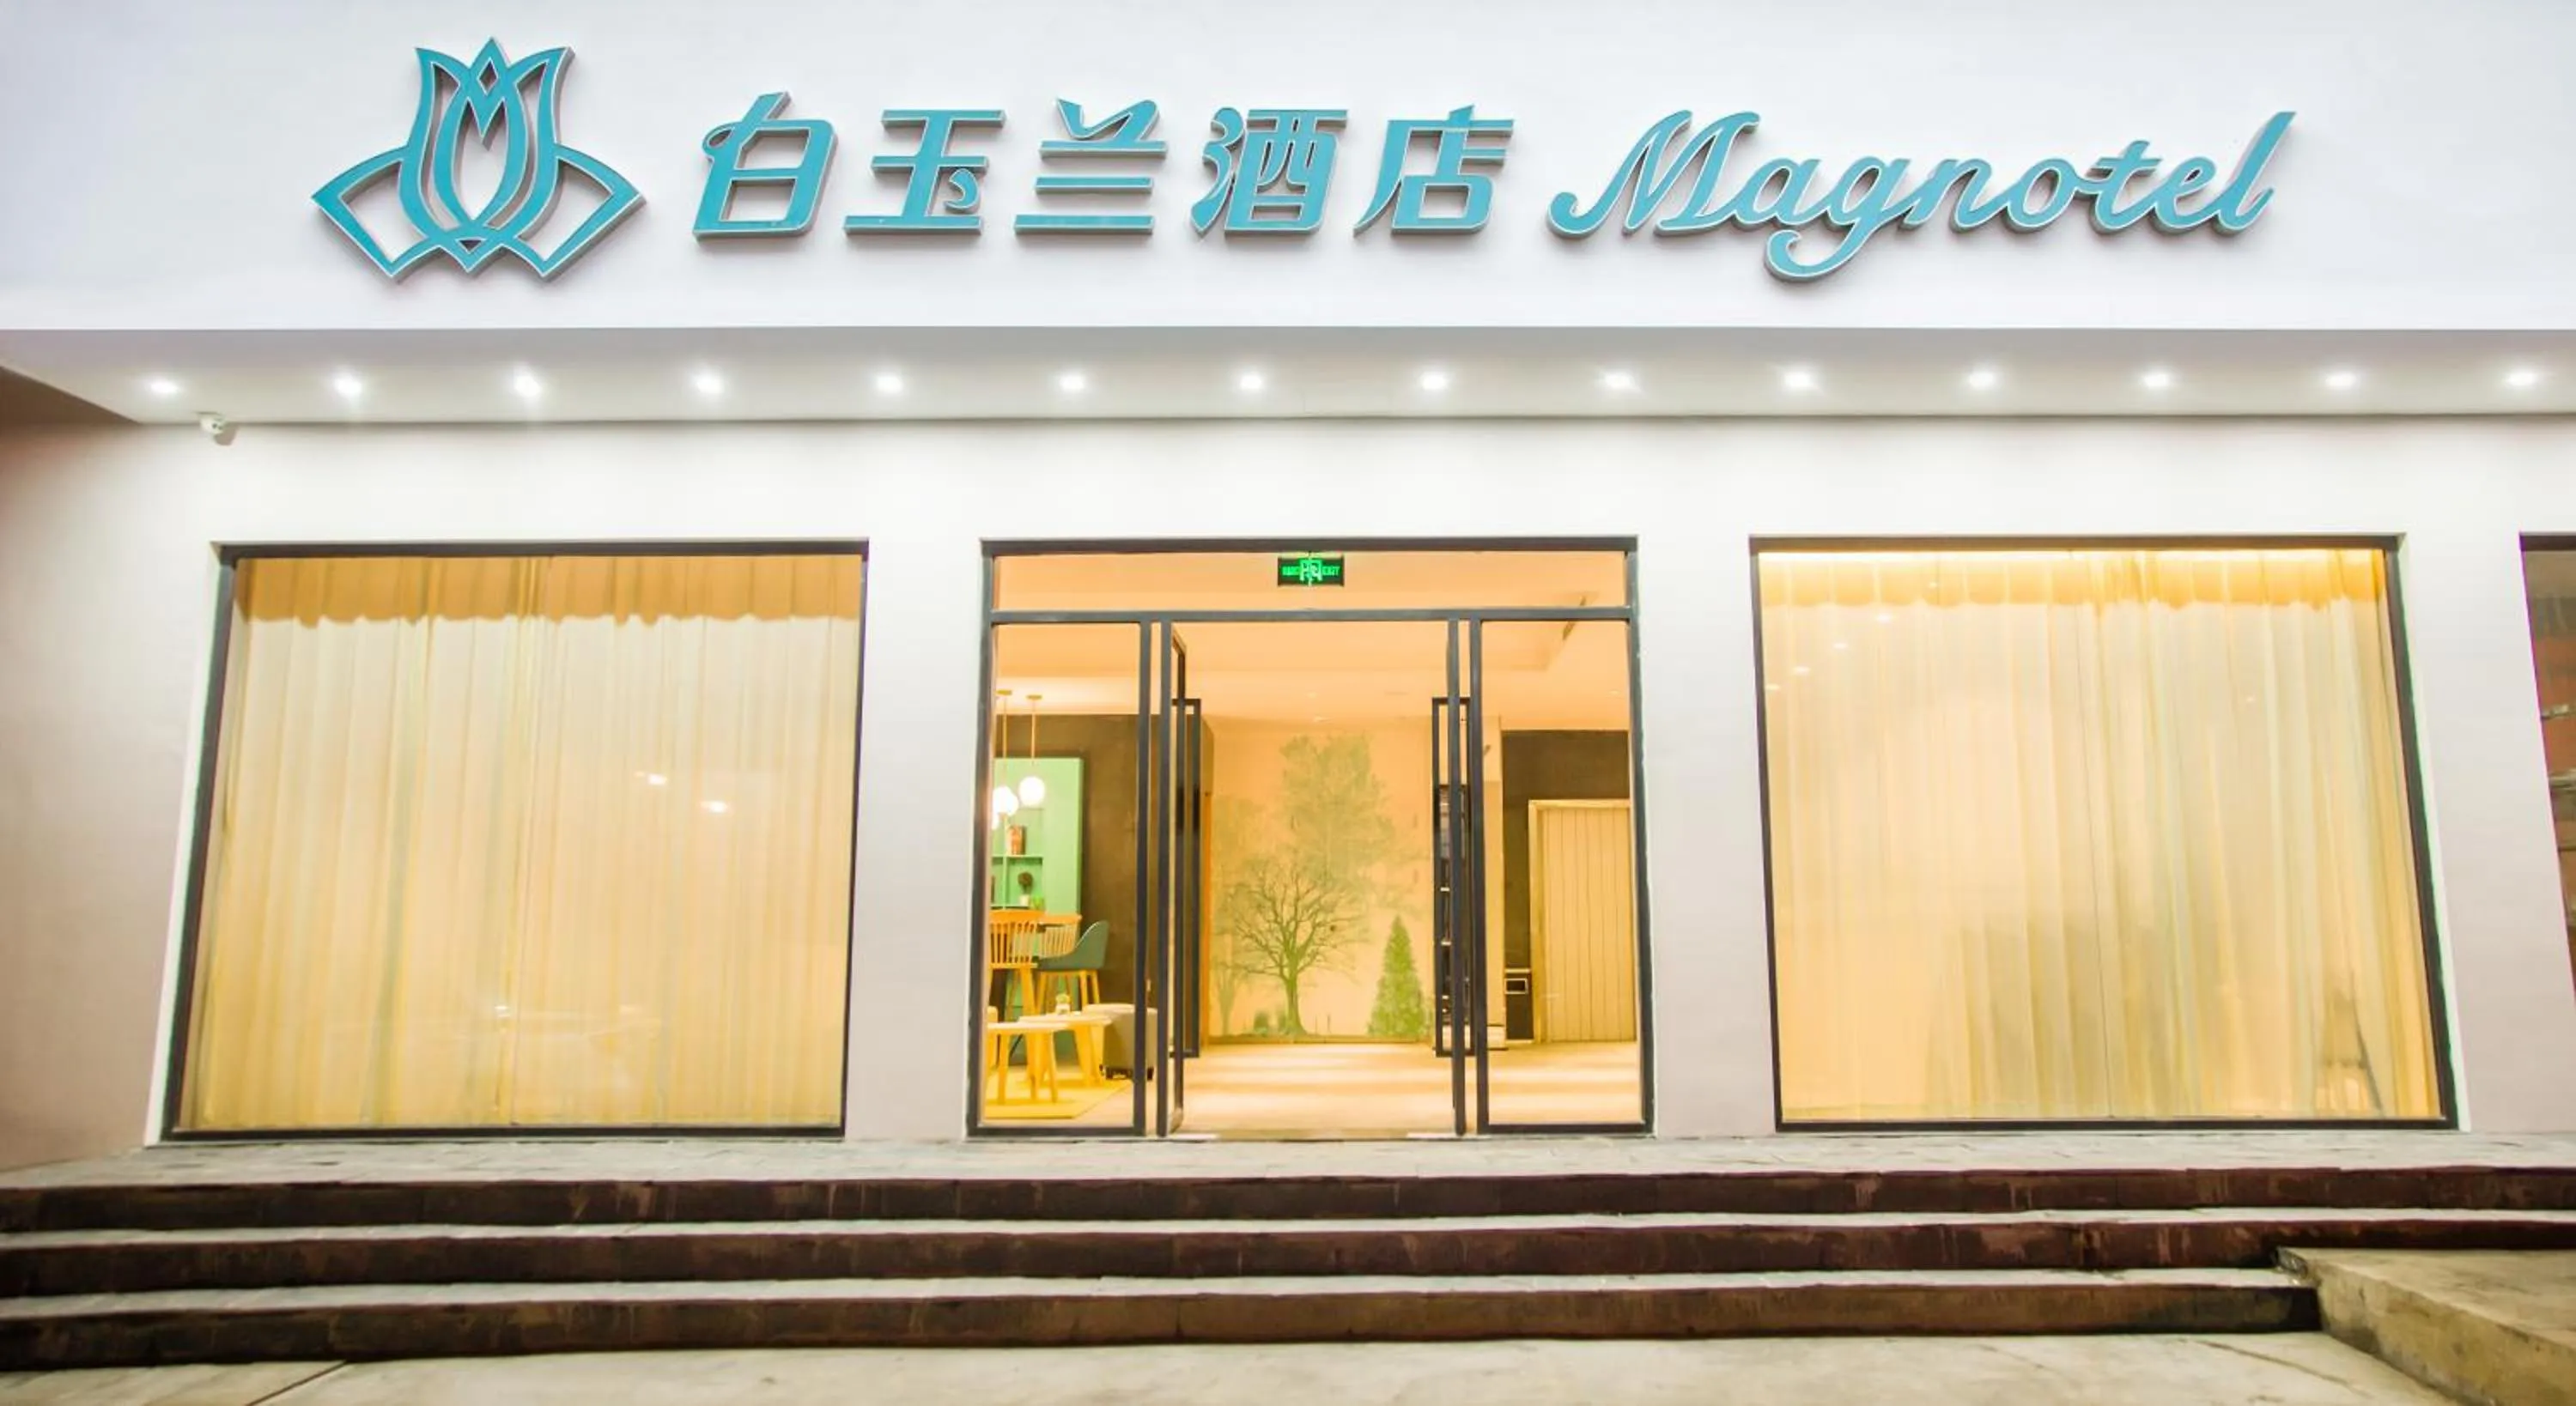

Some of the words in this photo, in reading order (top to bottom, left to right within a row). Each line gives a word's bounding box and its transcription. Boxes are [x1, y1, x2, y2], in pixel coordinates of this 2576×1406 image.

[691, 92, 1515, 239] 白玉兰酒店
[1547, 110, 2296, 279] Magnotel
